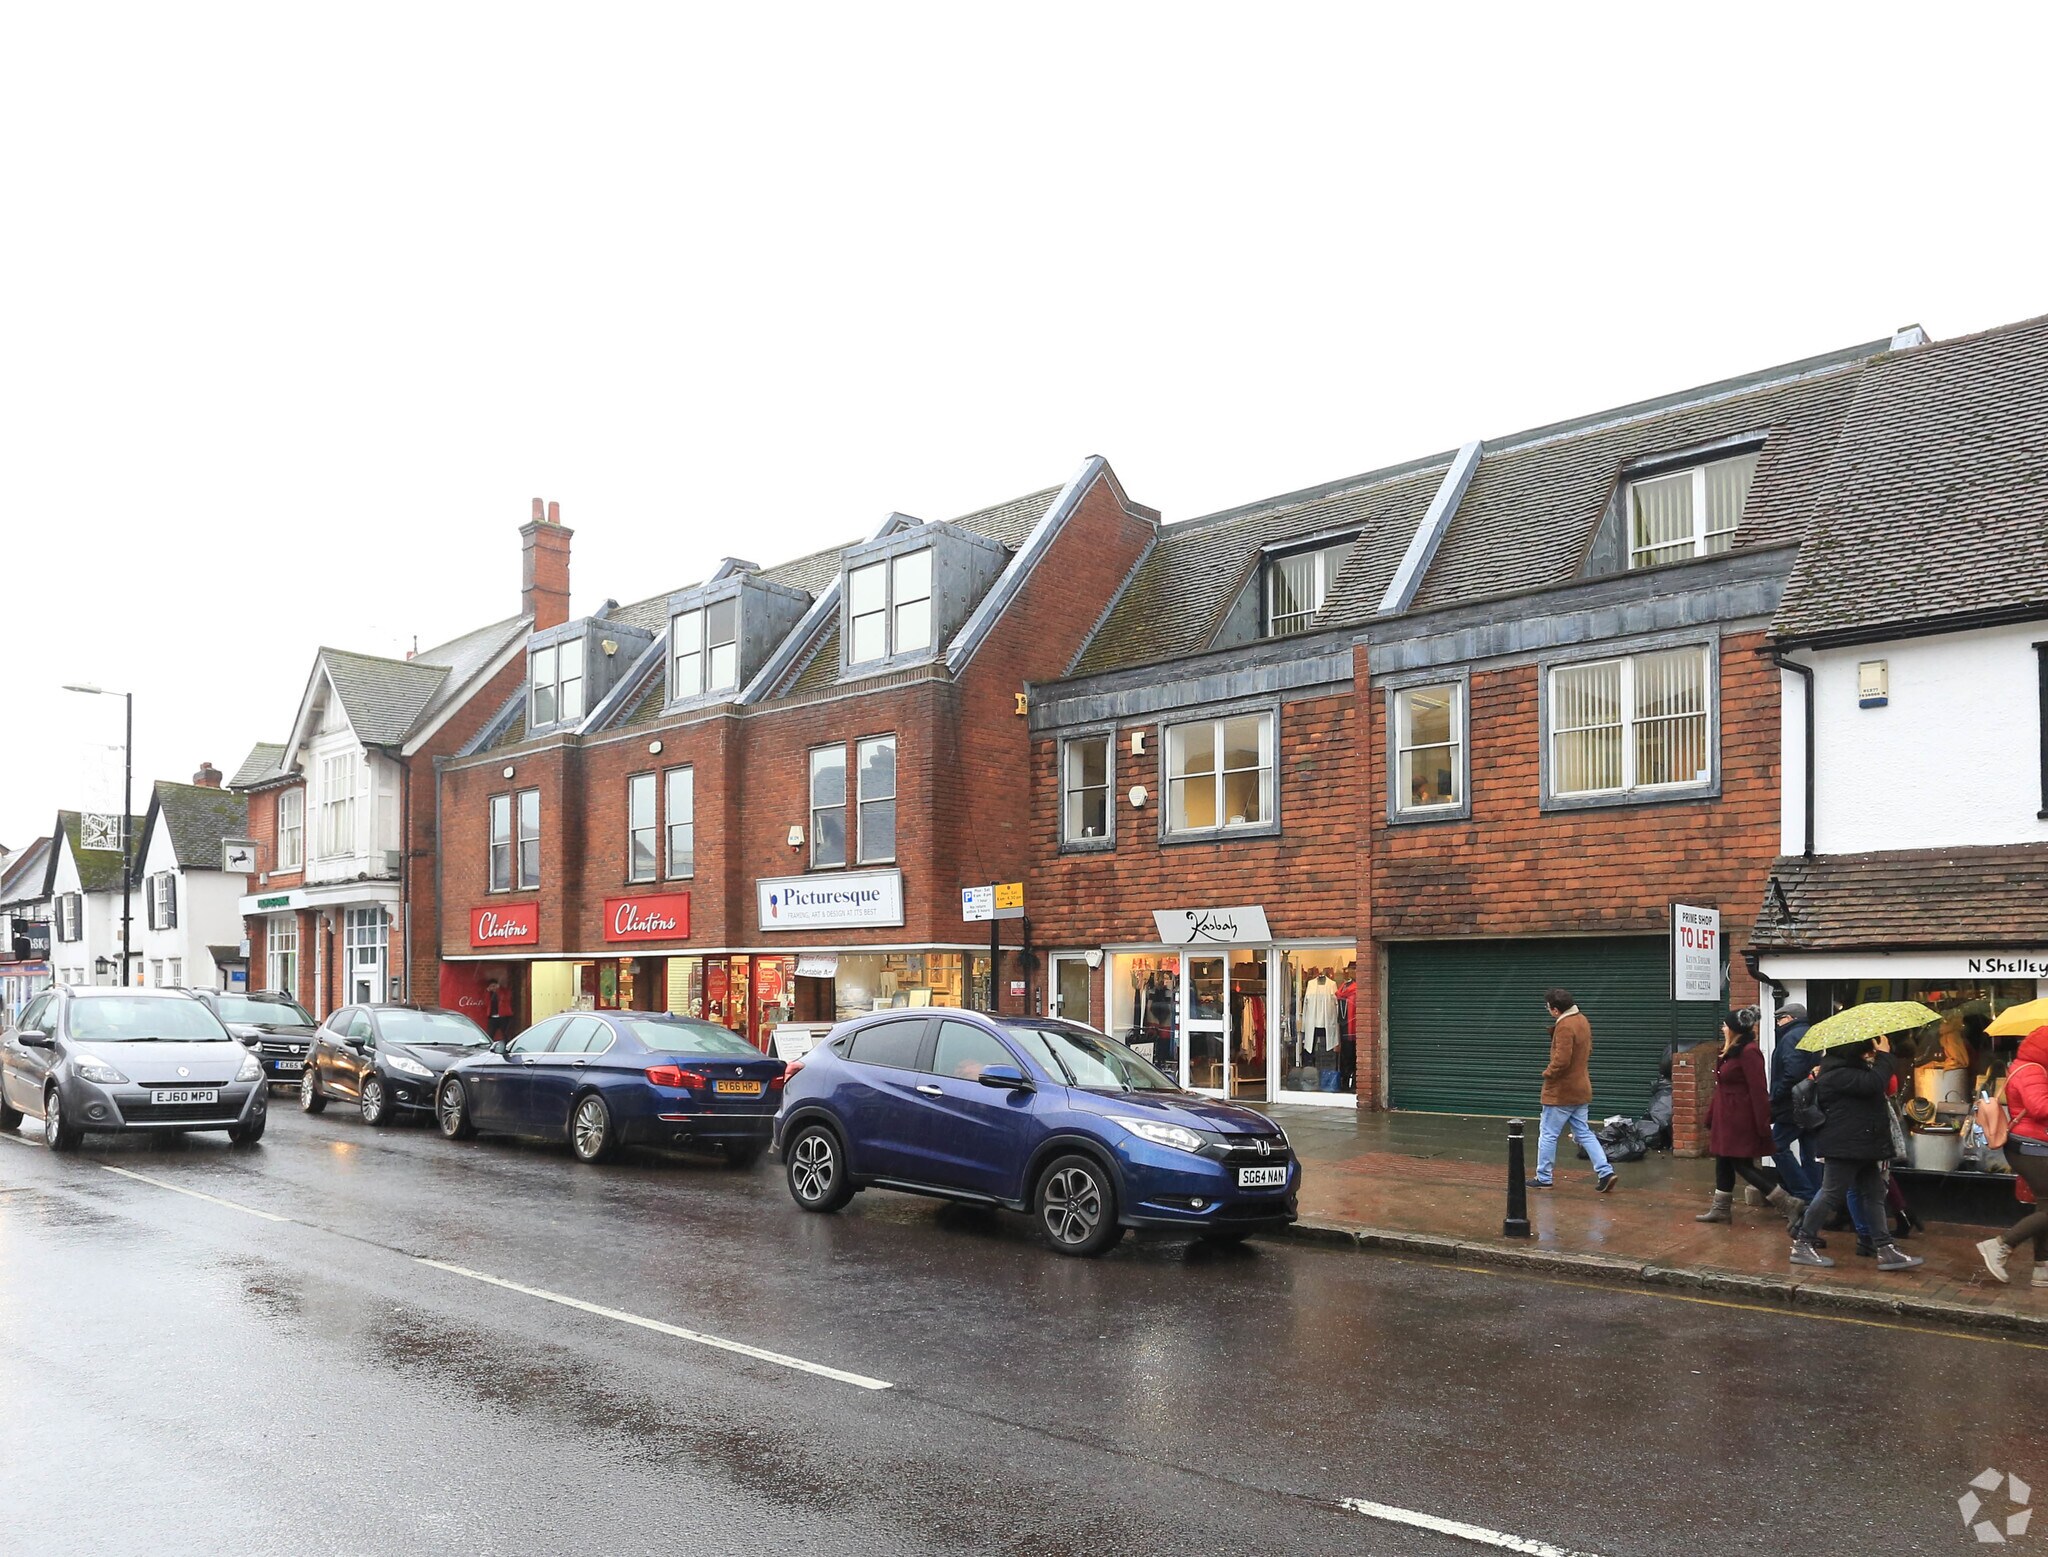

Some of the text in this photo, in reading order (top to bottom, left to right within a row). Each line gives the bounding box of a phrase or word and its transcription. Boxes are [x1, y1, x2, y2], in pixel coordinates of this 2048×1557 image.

[783, 888, 880, 907] Picturesque
[614, 903, 677, 935] Clintons
[826, 909, 846, 918] DESIGN
[863, 908, 877, 916] BEST
[1682, 911, 1712, 926] PRIME SHOP
[478, 911, 528, 940] Clintons
[1186, 911, 1237, 943] Kasbah
[1681, 926, 1715, 950] TO LET
[1968, 958, 2048, 978] N.Shelley
[280, 1061, 298, 1069] EX65
[718, 1081, 759, 1091] EY66 HRJ
[157, 1091, 213, 1102] EJ60 MPO
[1243, 1169, 1284, 1183] SG64 NAN
